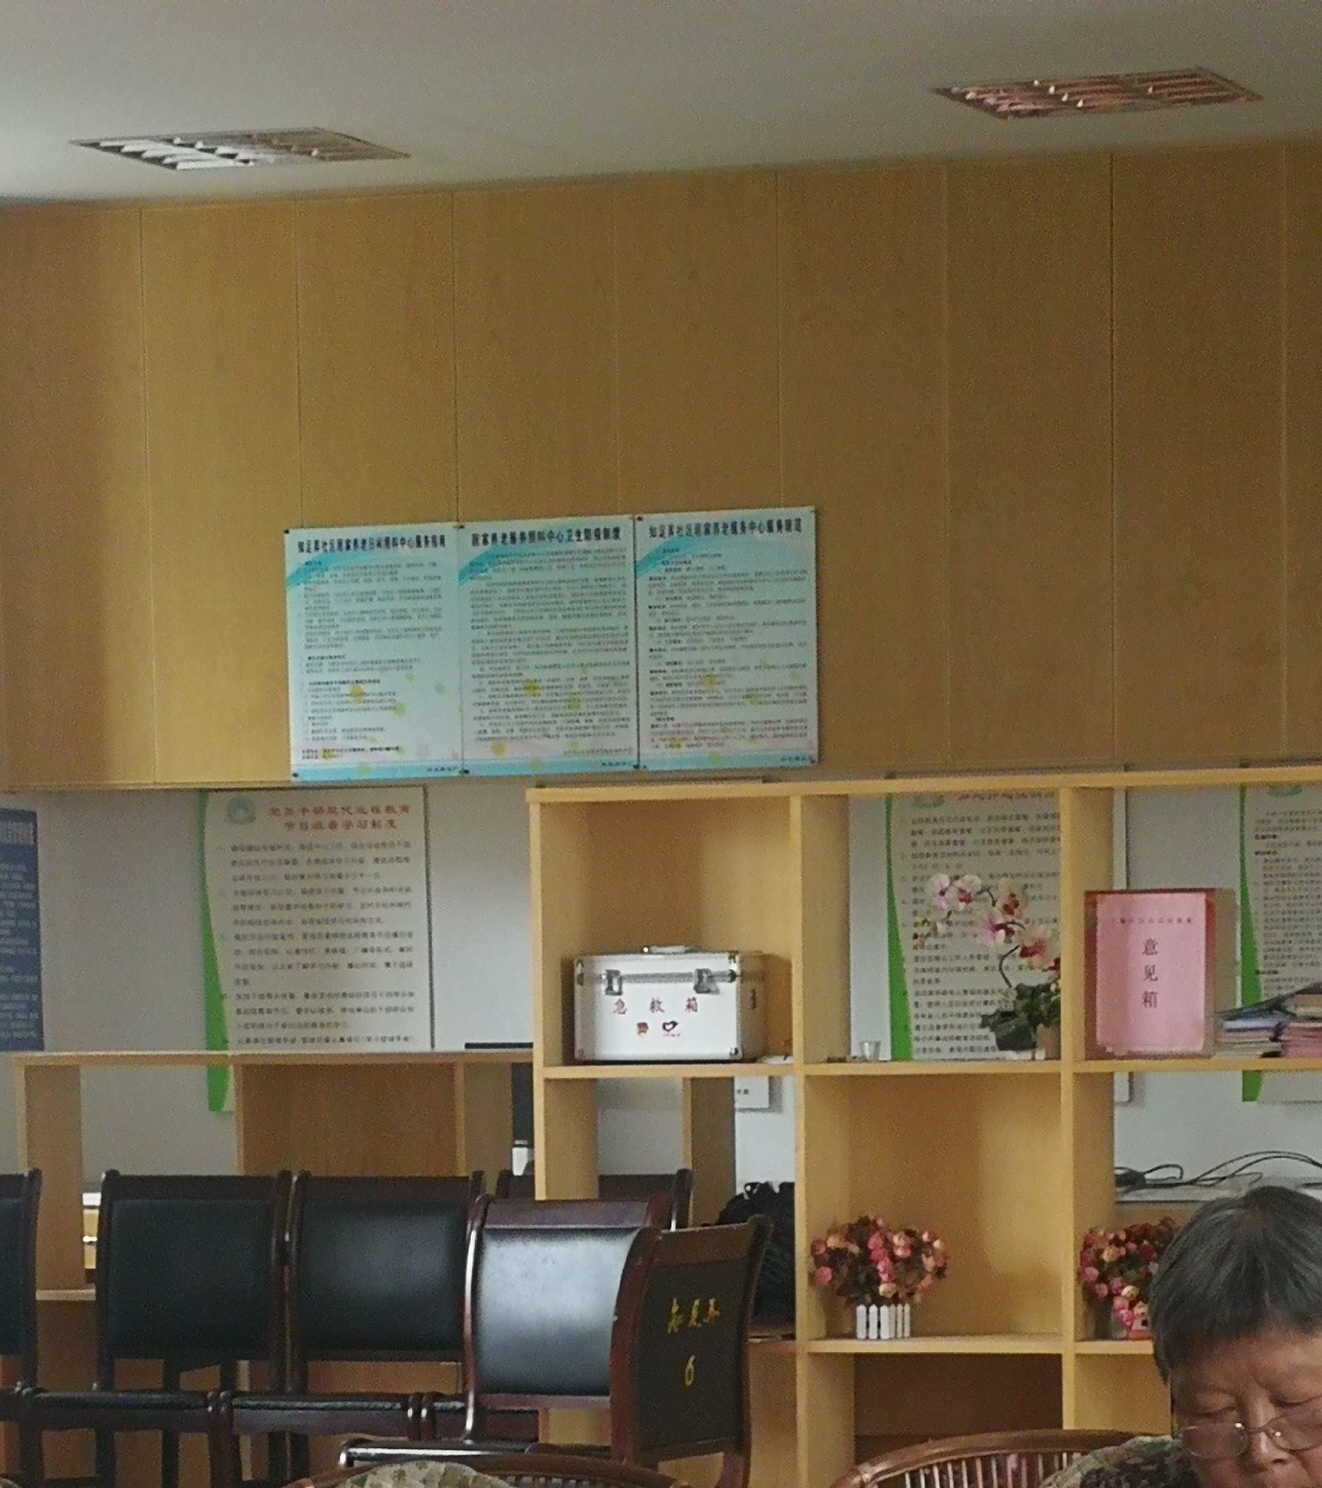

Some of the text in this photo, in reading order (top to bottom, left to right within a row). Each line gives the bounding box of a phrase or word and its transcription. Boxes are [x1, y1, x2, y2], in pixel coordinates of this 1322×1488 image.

[1142, 937, 1159, 1009] 意见箱
[613, 996, 699, 1015] 急救箱
